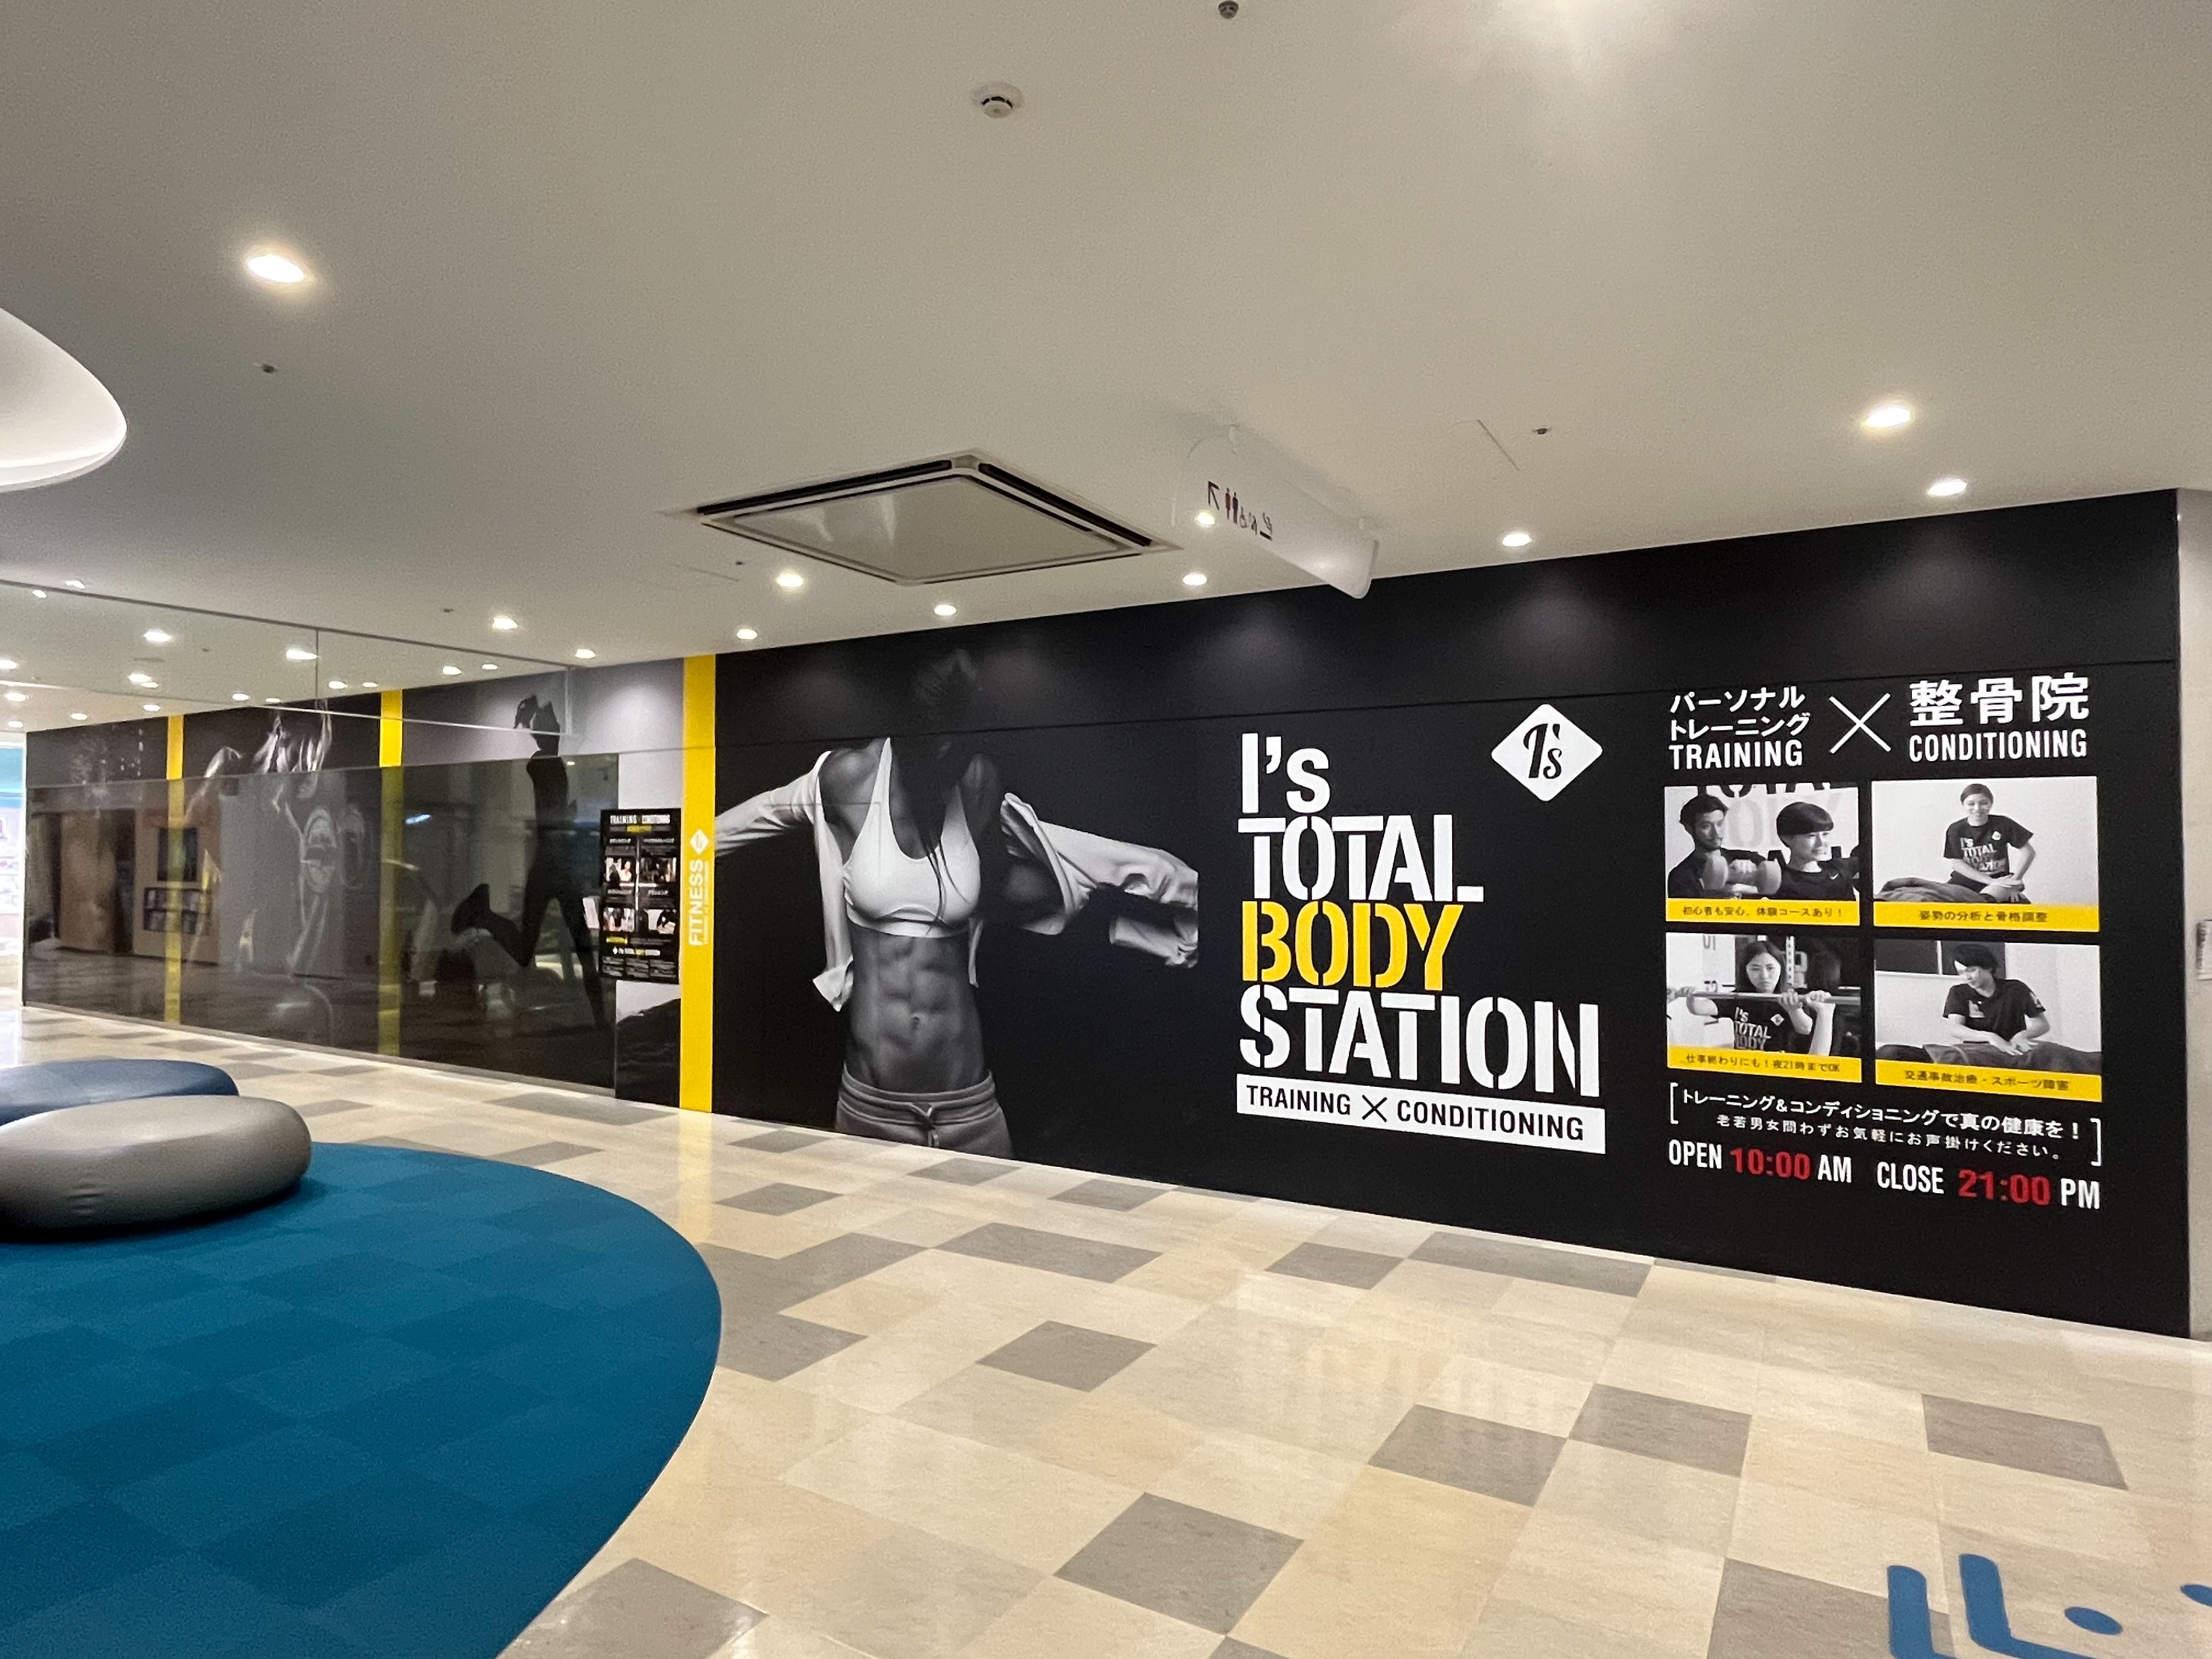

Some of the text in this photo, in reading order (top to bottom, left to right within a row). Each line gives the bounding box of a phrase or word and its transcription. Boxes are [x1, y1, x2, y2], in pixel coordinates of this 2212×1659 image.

[1670, 686, 1805, 713] パーソナル
[1671, 712, 1810, 741] トレーニング
[1909, 672, 2089, 727] 整骨院
[1668, 739, 1803, 770] TRAINING
[1909, 729, 2087, 762] CONDITIONING
[1242, 733, 1331, 814] I's
[1238, 814, 1484, 902] TOTAL
[688, 859, 703, 946] FITNESS
[1242, 900, 1464, 991] BODY
[1239, 984, 1600, 1097] STATION
[1246, 1085, 1352, 1116] TRAINING
[1397, 1099, 1584, 1141] CONDITIONING
[1669, 1139, 1852, 1183] OPEN 10:00 AM
[1877, 1161, 2100, 1210] CLOSE 21:00 PM
